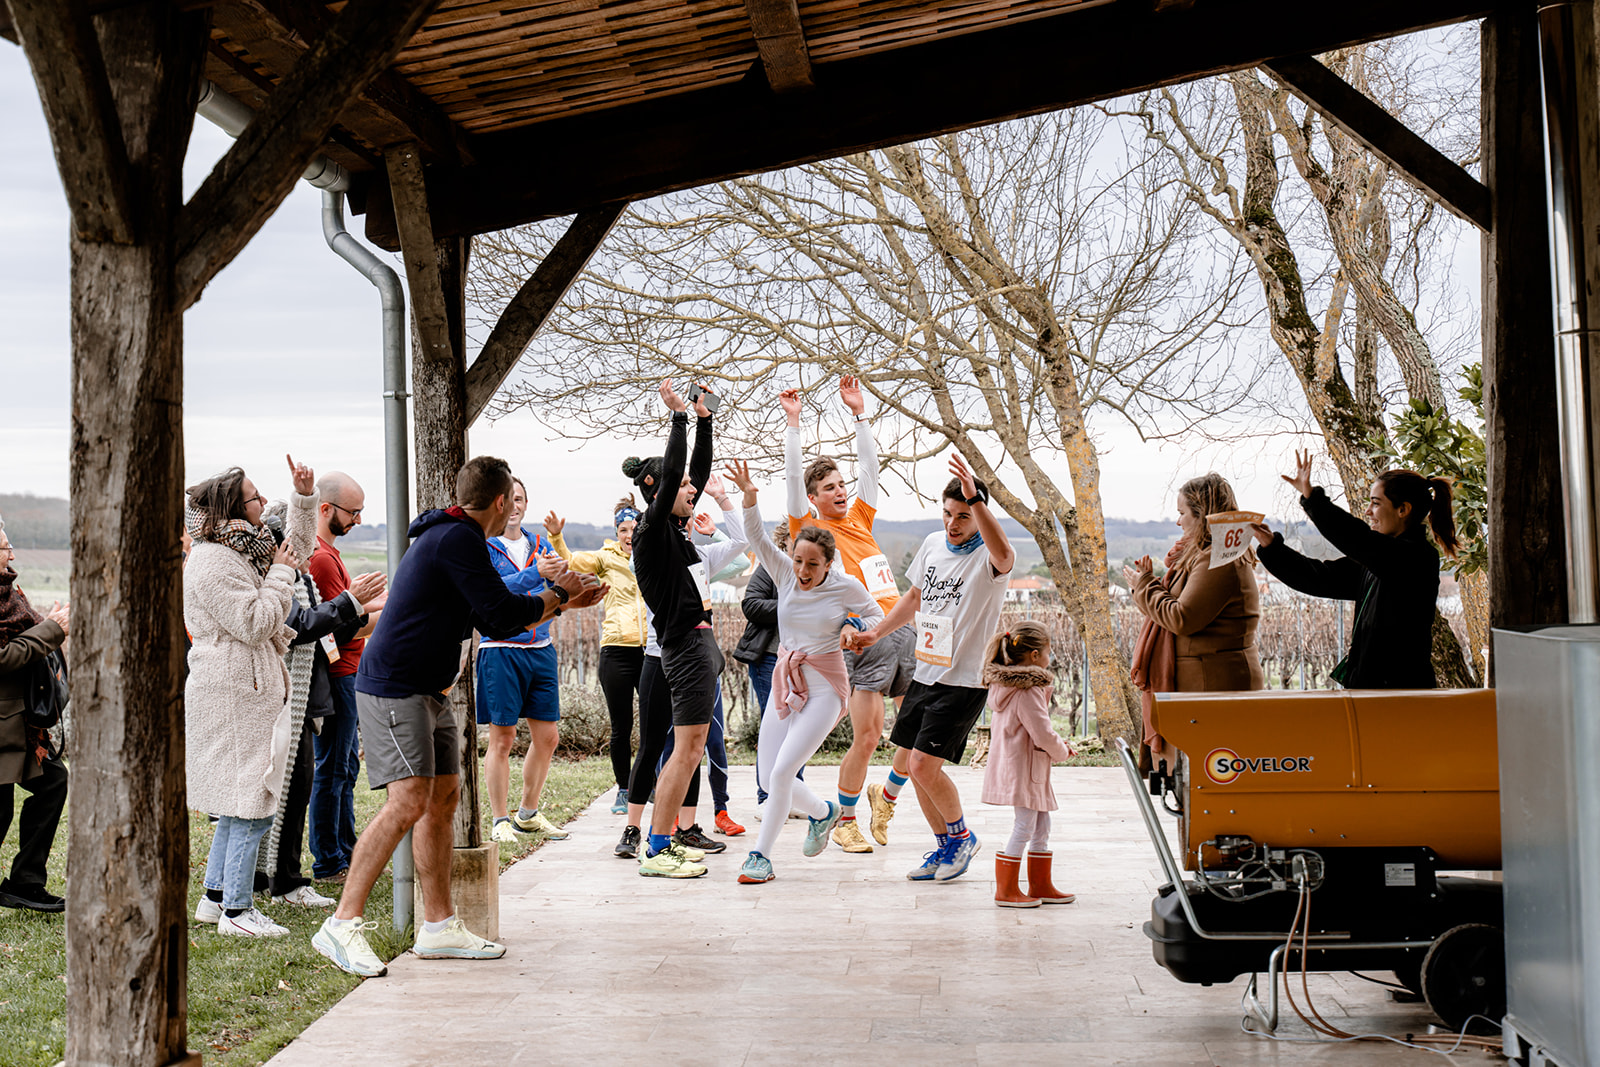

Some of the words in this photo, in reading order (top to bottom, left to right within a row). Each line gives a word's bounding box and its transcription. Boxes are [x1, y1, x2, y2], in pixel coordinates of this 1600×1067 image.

[1224, 528, 1244, 549] 39
[924, 631, 934, 649] 2
[1216, 757, 1312, 773] SOVELOR
